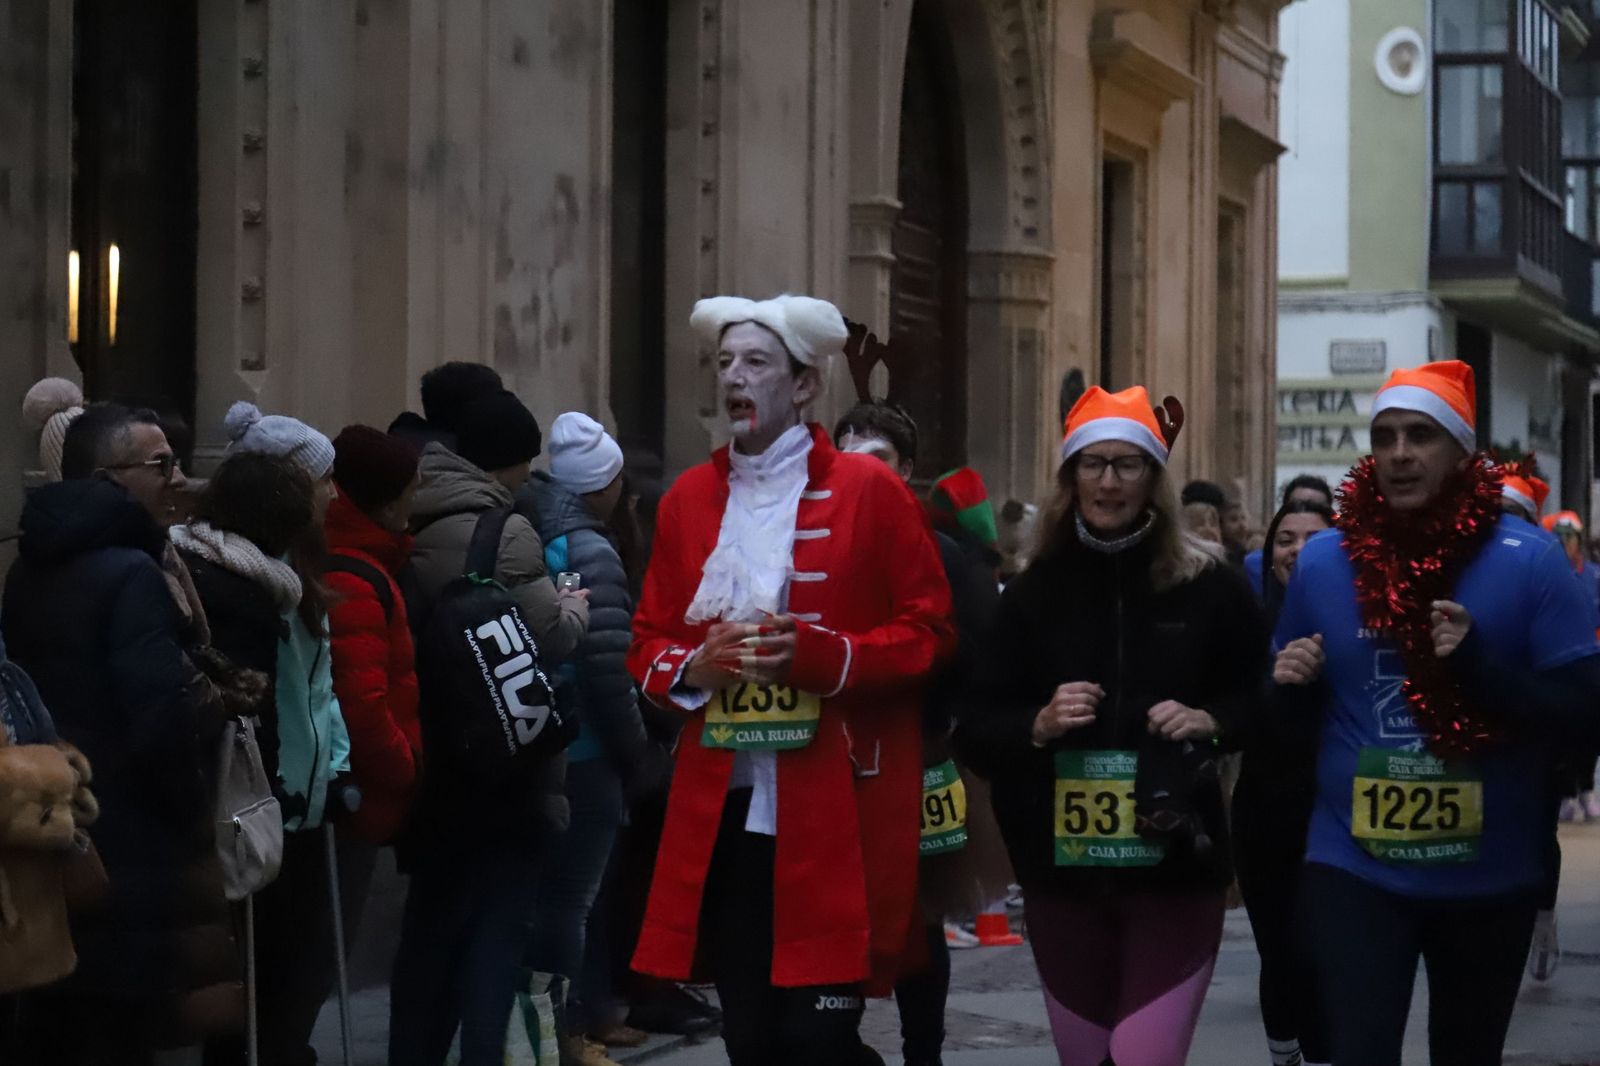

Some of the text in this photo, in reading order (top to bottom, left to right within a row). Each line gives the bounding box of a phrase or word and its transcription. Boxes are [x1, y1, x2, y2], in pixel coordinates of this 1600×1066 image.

[476, 614, 550, 745] FILA
[768, 728, 812, 742] RURAL
[1362, 782, 1461, 831] 1225
[1425, 842, 1473, 858] RURAL
